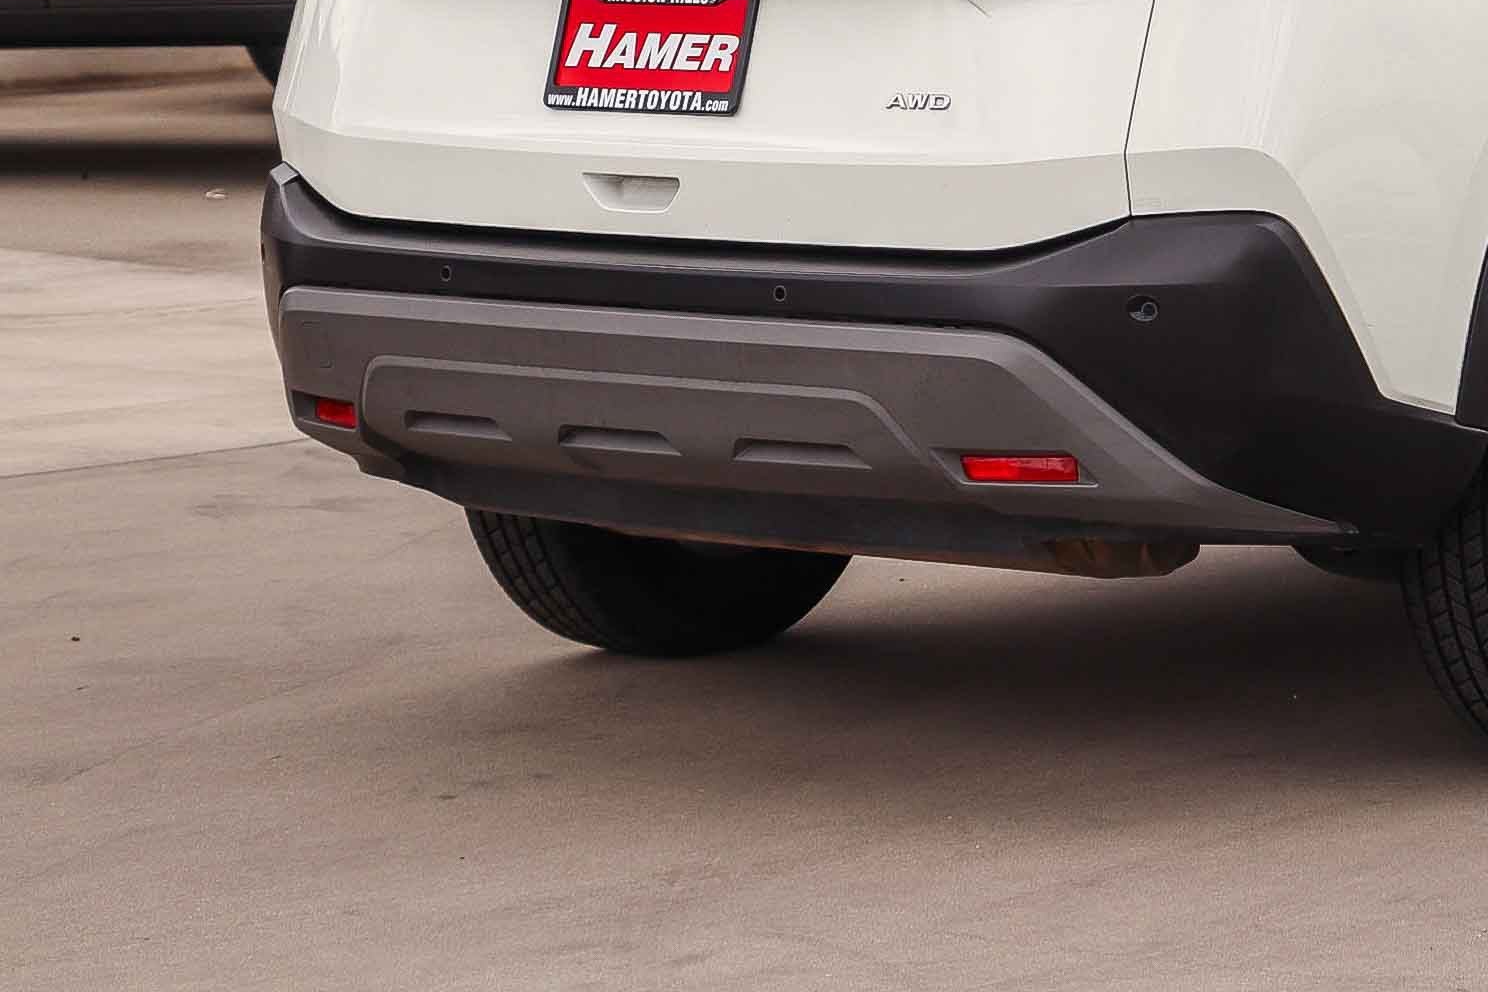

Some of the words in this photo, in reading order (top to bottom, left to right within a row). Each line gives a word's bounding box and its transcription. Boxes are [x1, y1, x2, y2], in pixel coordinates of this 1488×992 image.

[564, 22, 741, 73] HAMER
[547, 86, 730, 113] www.HAMERTOYOTA.com
[886, 93, 952, 111] AWD
